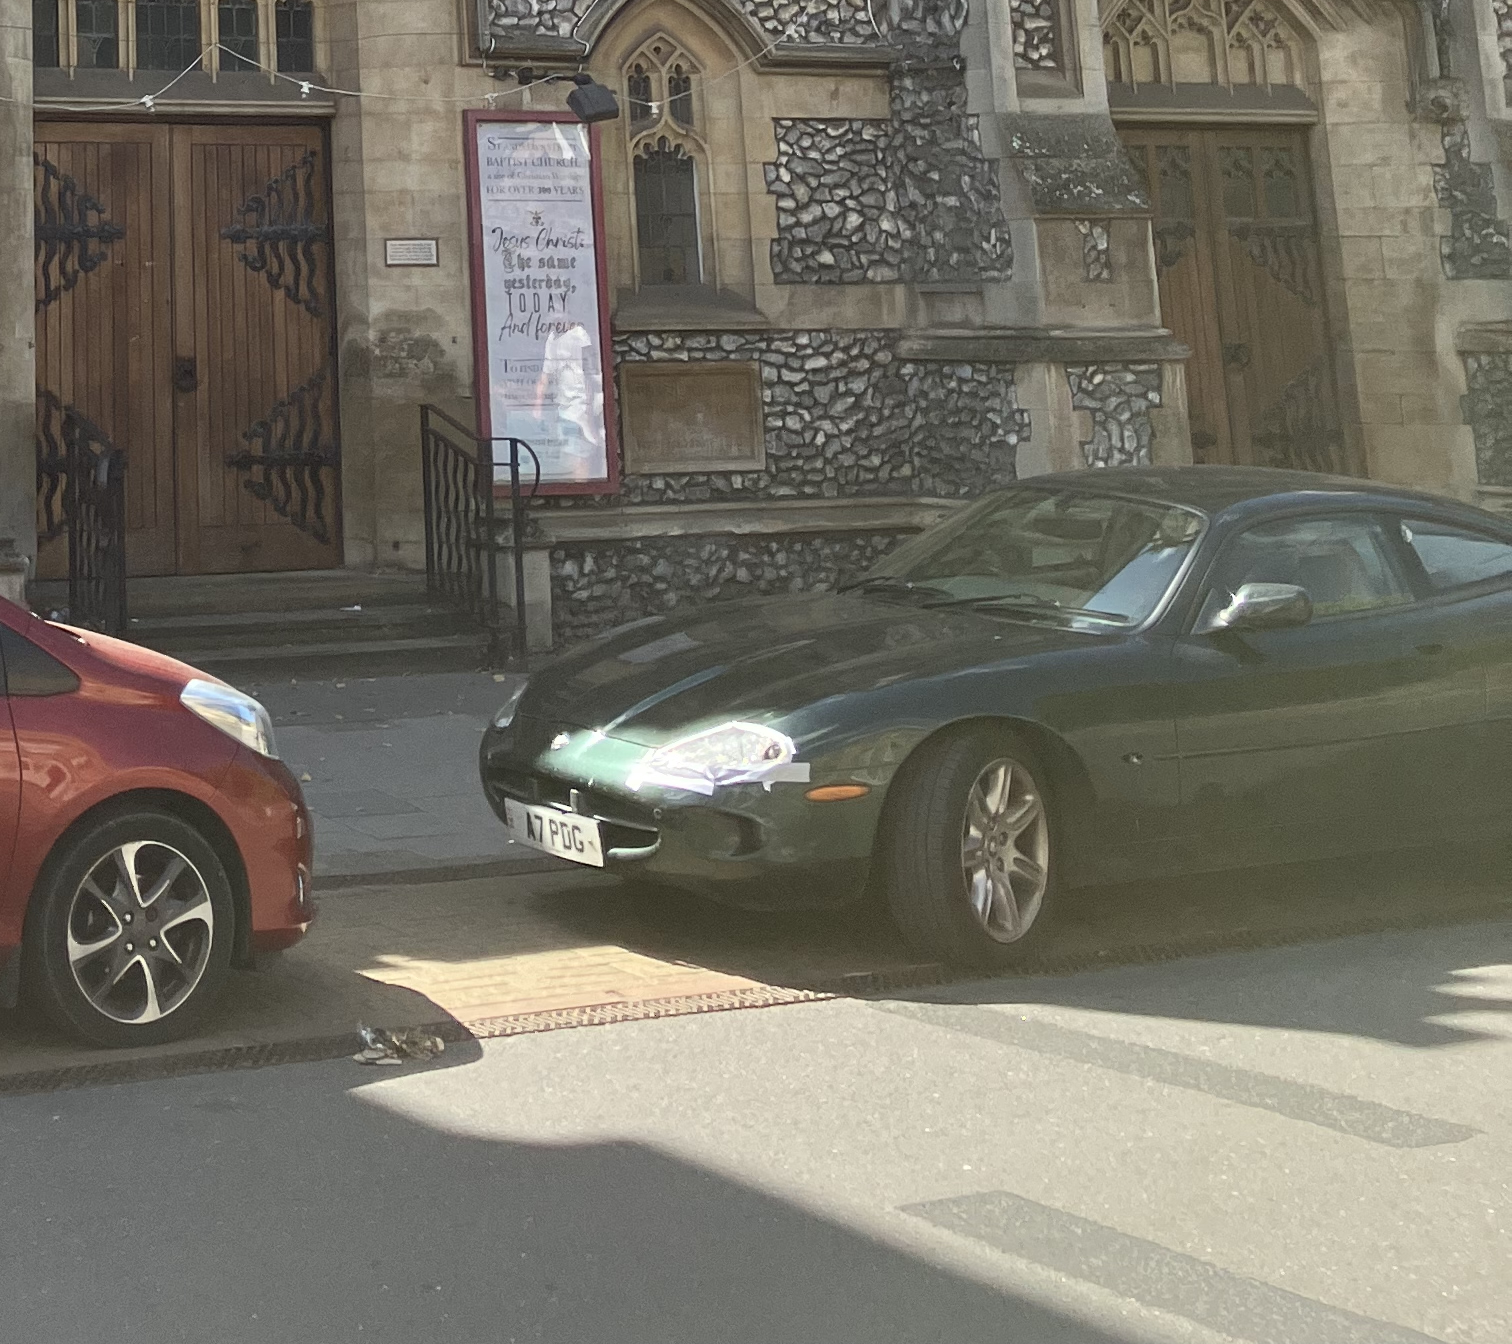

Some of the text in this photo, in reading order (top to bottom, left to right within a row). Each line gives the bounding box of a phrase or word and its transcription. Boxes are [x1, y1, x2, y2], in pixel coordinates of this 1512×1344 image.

[486, 156, 528, 167] BAPTIST
[486, 185, 584, 195] FOR OVER 300 YEARS
[491, 226, 585, 253] Jesus Christ:
[502, 248, 576, 273] The same
[503, 273, 577, 294] yesterday,
[506, 292, 568, 313] TODAY
[498, 311, 534, 342] And
[526, 810, 544, 844] A7
[548, 818, 586, 854] PDG
